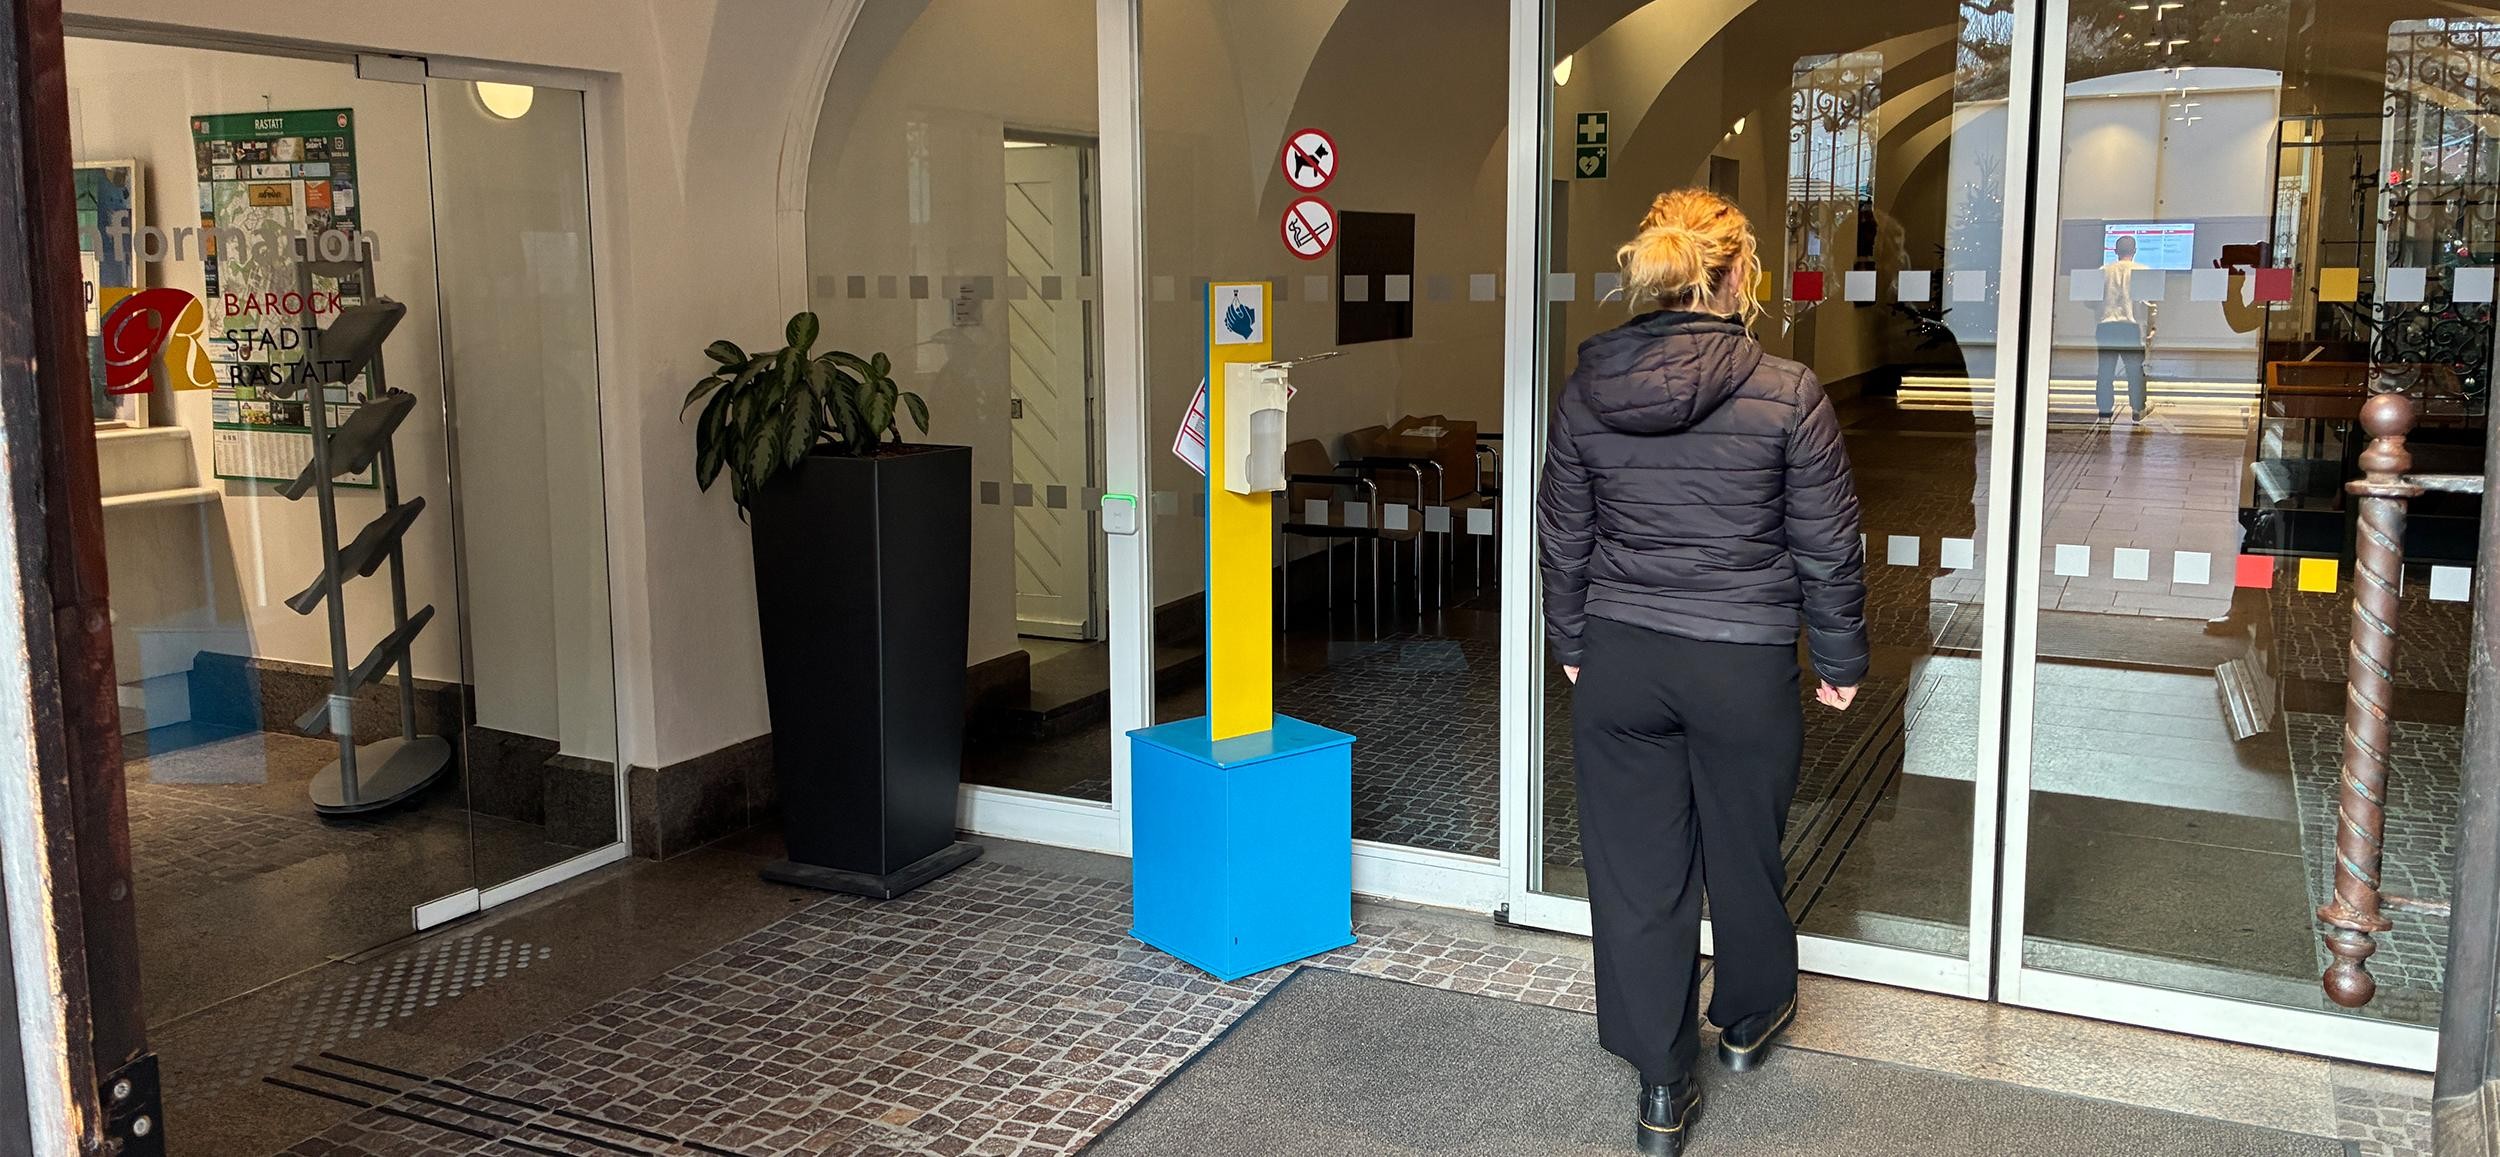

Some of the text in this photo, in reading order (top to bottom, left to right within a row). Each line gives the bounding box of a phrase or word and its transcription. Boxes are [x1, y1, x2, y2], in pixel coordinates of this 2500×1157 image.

[254, 118, 284, 130] RASTATT
[78, 210, 380, 263] nformation
[224, 291, 347, 316] BAROCK
[226, 326, 319, 352] STADT
[230, 359, 351, 387] RASTATT
